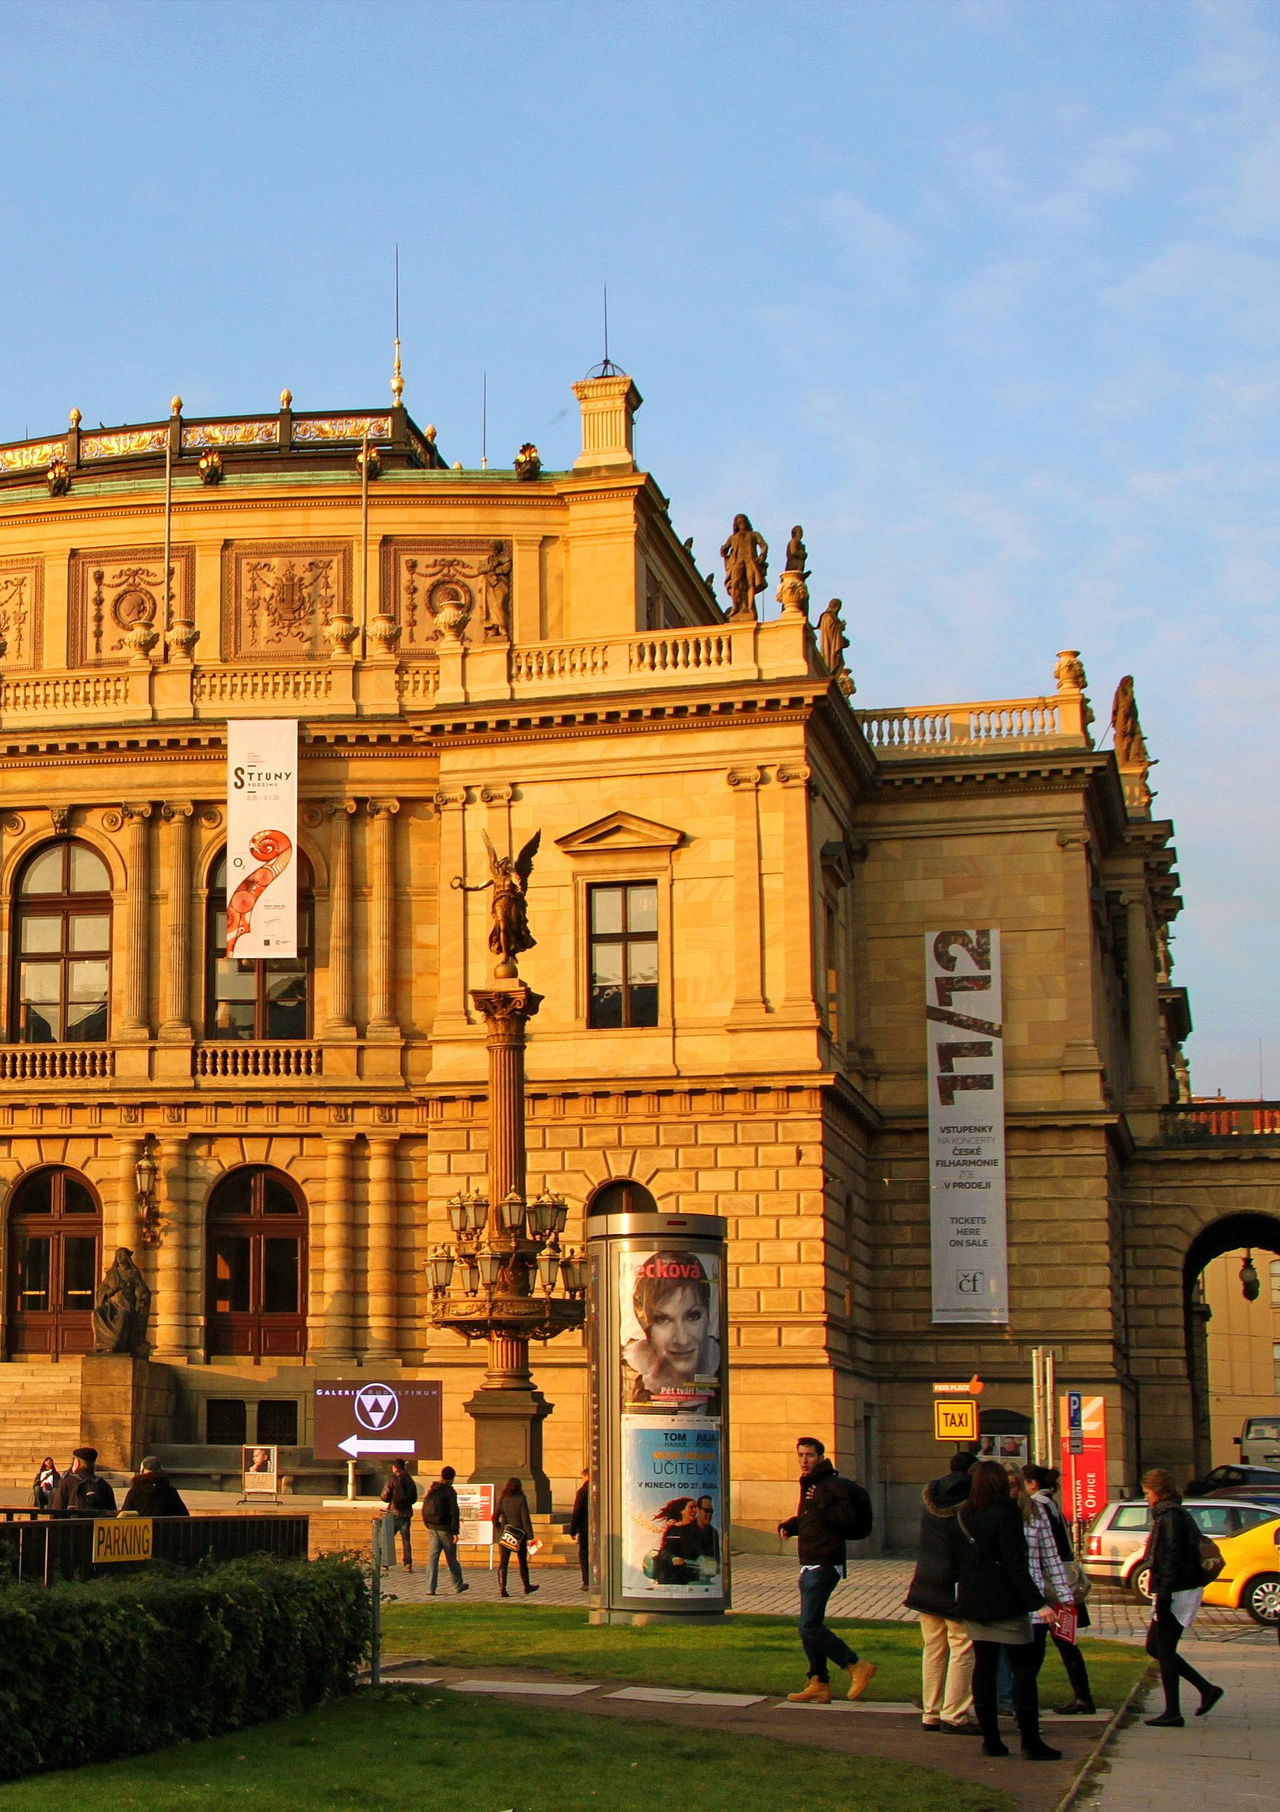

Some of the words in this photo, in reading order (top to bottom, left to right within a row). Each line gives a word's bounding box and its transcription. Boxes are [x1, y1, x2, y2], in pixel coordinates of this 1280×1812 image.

[939, 1125, 994, 1134] VSTUPENKY
[937, 1137, 950, 1145] NA
[951, 1136, 996, 1145] KONCERTY
[952, 1146, 982, 1156] ČESKÉ
[935, 1159, 999, 1168] FILHARMONIE
[943, 1182, 951, 1190] V
[952, 1182, 991, 1190] PRODEJI
[950, 1217, 987, 1225] TICKETS
[956, 1228, 981, 1236] HERE
[949, 1239, 964, 1247] ON
[965, 1239, 989, 1247] SALE
[1070, 1396, 1080, 1418] P
[942, 1412, 969, 1428] TAXI
[663, 1433, 687, 1441] TOM
[653, 1460, 717, 1476] UČITELKA
[644, 1481, 676, 1489] KINECH
[1085, 1473, 1097, 1509] OFFICE
[97, 1524, 150, 1558] PARKING
